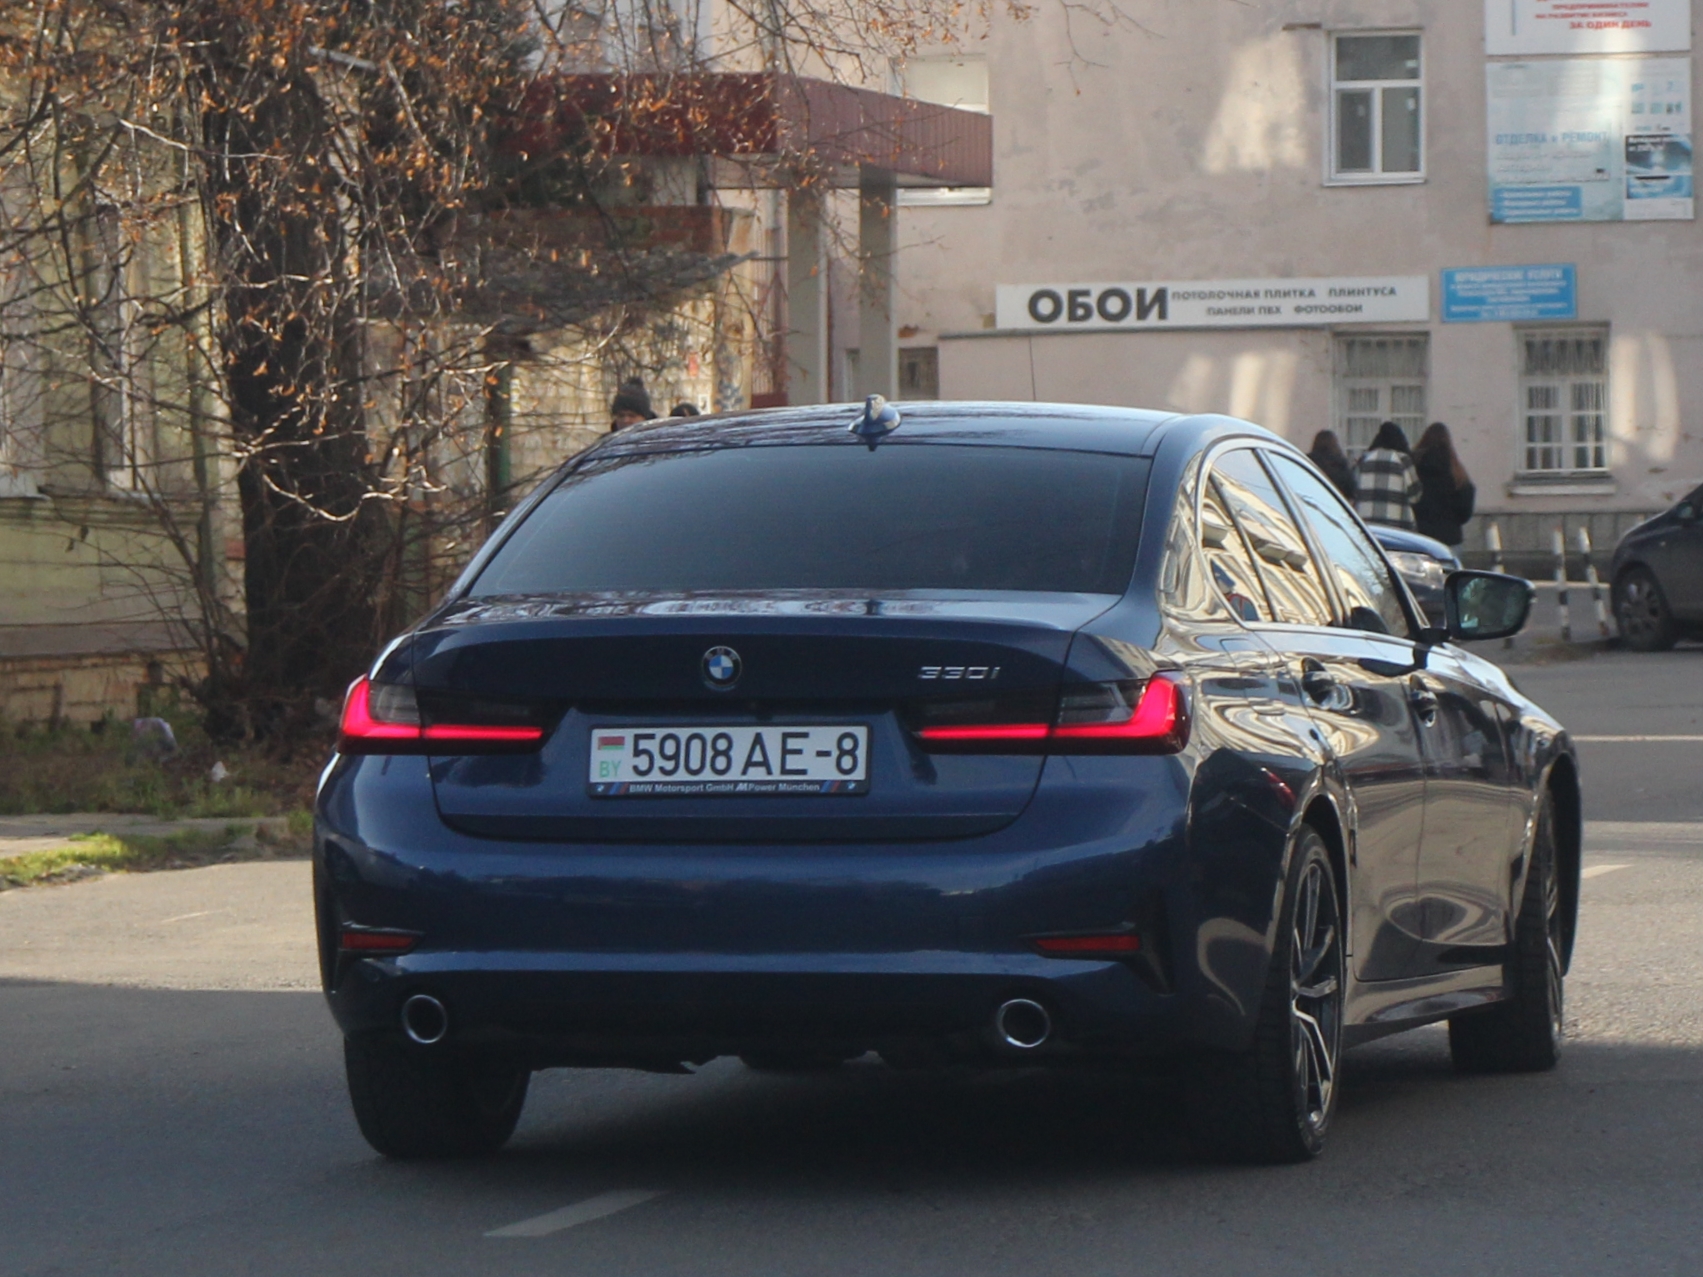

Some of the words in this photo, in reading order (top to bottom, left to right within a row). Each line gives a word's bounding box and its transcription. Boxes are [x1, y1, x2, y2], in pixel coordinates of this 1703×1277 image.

[1569, 21, 1584, 29] ЗА
[1586, 21, 1619, 30] ОДИН
[1621, 20, 1652, 29] ДЕНЬ
[1496, 133, 1547, 145] ОТДЕЛКА
[1562, 131, 1608, 143] РЕМОНТ
[1172, 289, 1261, 301] ПОТОЛОЧНАЯ
[1264, 288, 1316, 299] ПЛИТКА
[1328, 286, 1397, 297] ПЛИНТУСА
[1028, 287, 1169, 324] ОБОИ
[1207, 306, 1255, 316] ПАНЕЛИ
[1258, 305, 1282, 315] ПВХ
[1294, 304, 1363, 314] ФОТООБОИ
[918, 666, 1001, 680] 330i
[631, 732, 734, 777] 5908
[600, 760, 621, 777] BY
[629, 784, 652, 793] BMW
[654, 784, 704, 794] Motorsport
[706, 783, 734, 792] GmbH
[778, 782, 820, 791] München
